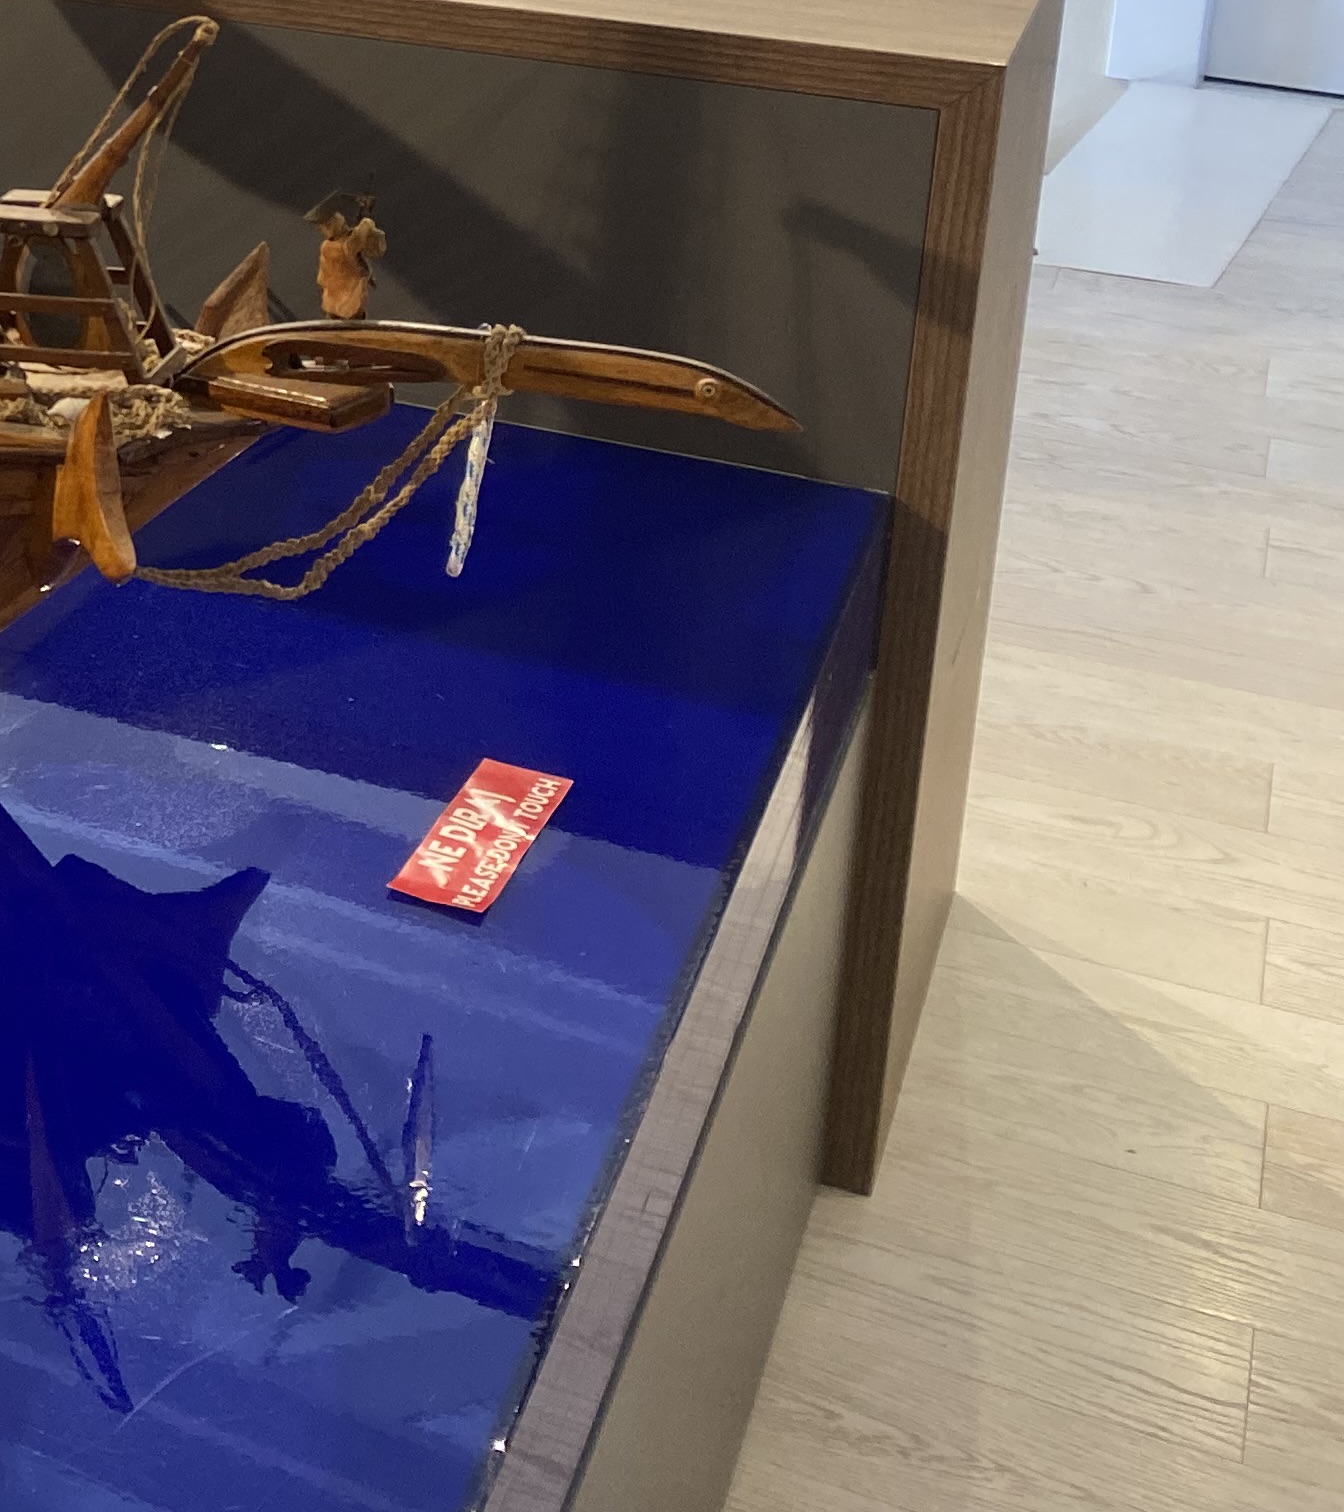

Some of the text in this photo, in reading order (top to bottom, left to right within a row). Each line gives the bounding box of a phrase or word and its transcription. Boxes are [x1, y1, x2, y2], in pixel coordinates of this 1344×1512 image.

[418, 840, 467, 873] NE
[452, 861, 508, 908] PLEASE
[514, 778, 561, 820] TOUCH
